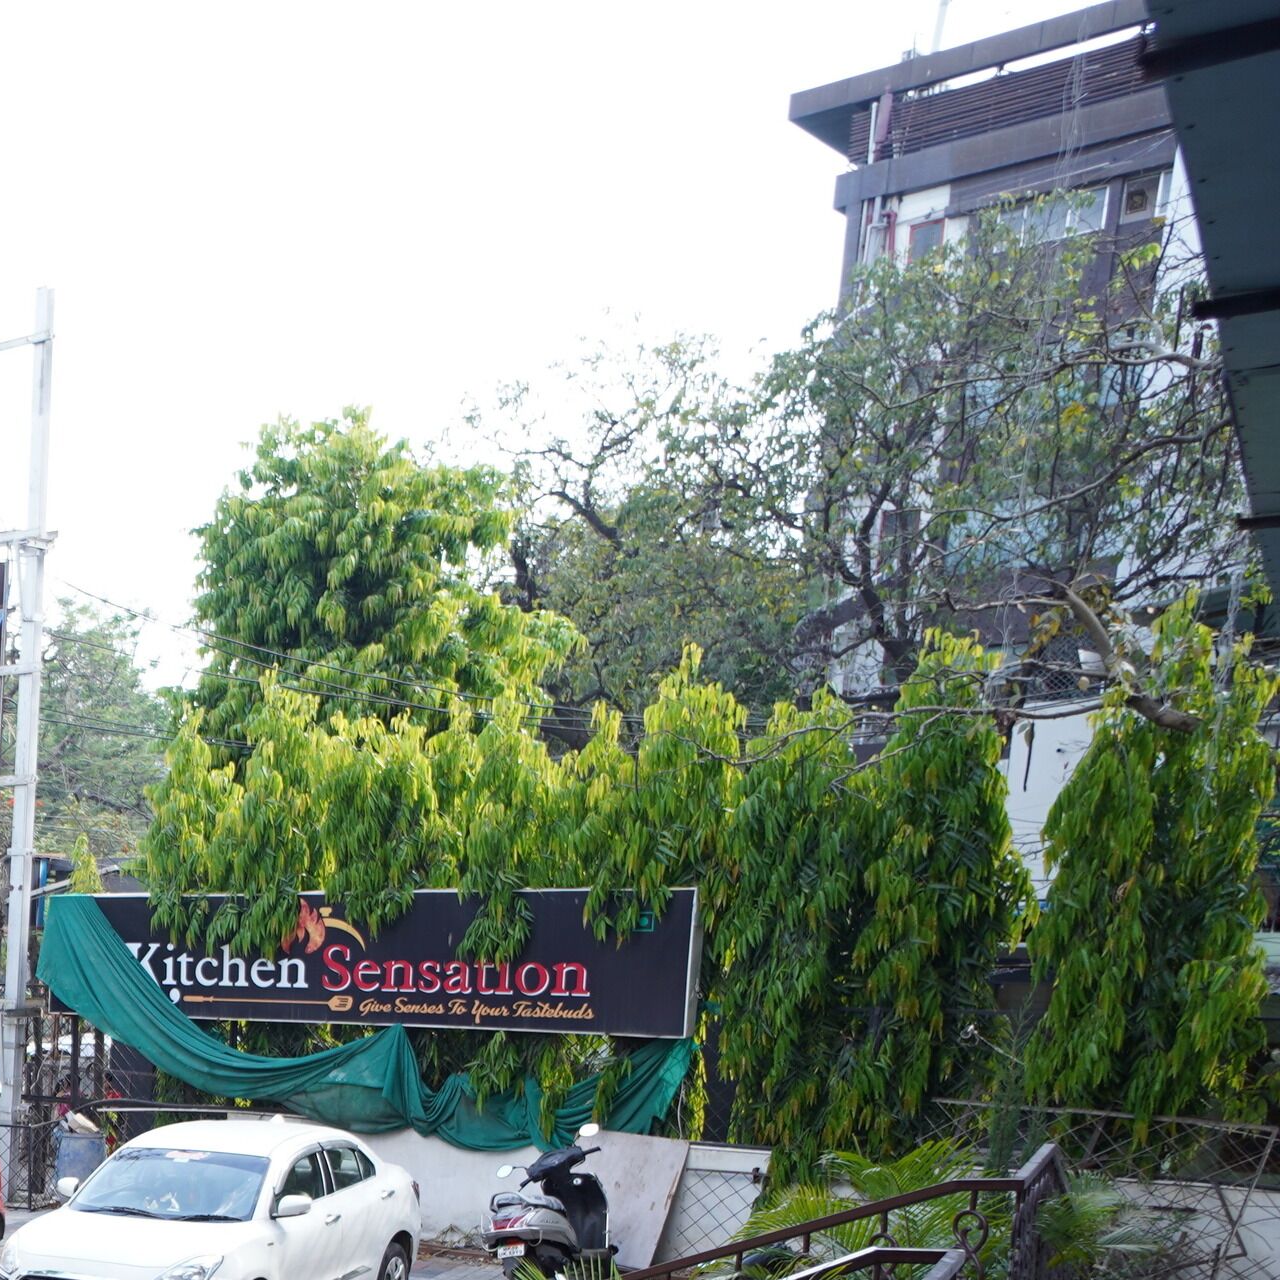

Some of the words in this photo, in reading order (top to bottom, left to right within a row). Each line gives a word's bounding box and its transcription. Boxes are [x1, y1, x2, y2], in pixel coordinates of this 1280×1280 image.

[126, 943, 308, 988] Kitchen
[321, 943, 590, 997] Sensation
[359, 997, 391, 1016] Give
[394, 997, 444, 1015] Senses
[448, 998, 467, 1015] To
[471, 1000, 510, 1024] Your
[512, 1000, 595, 1020] Tastebuds
